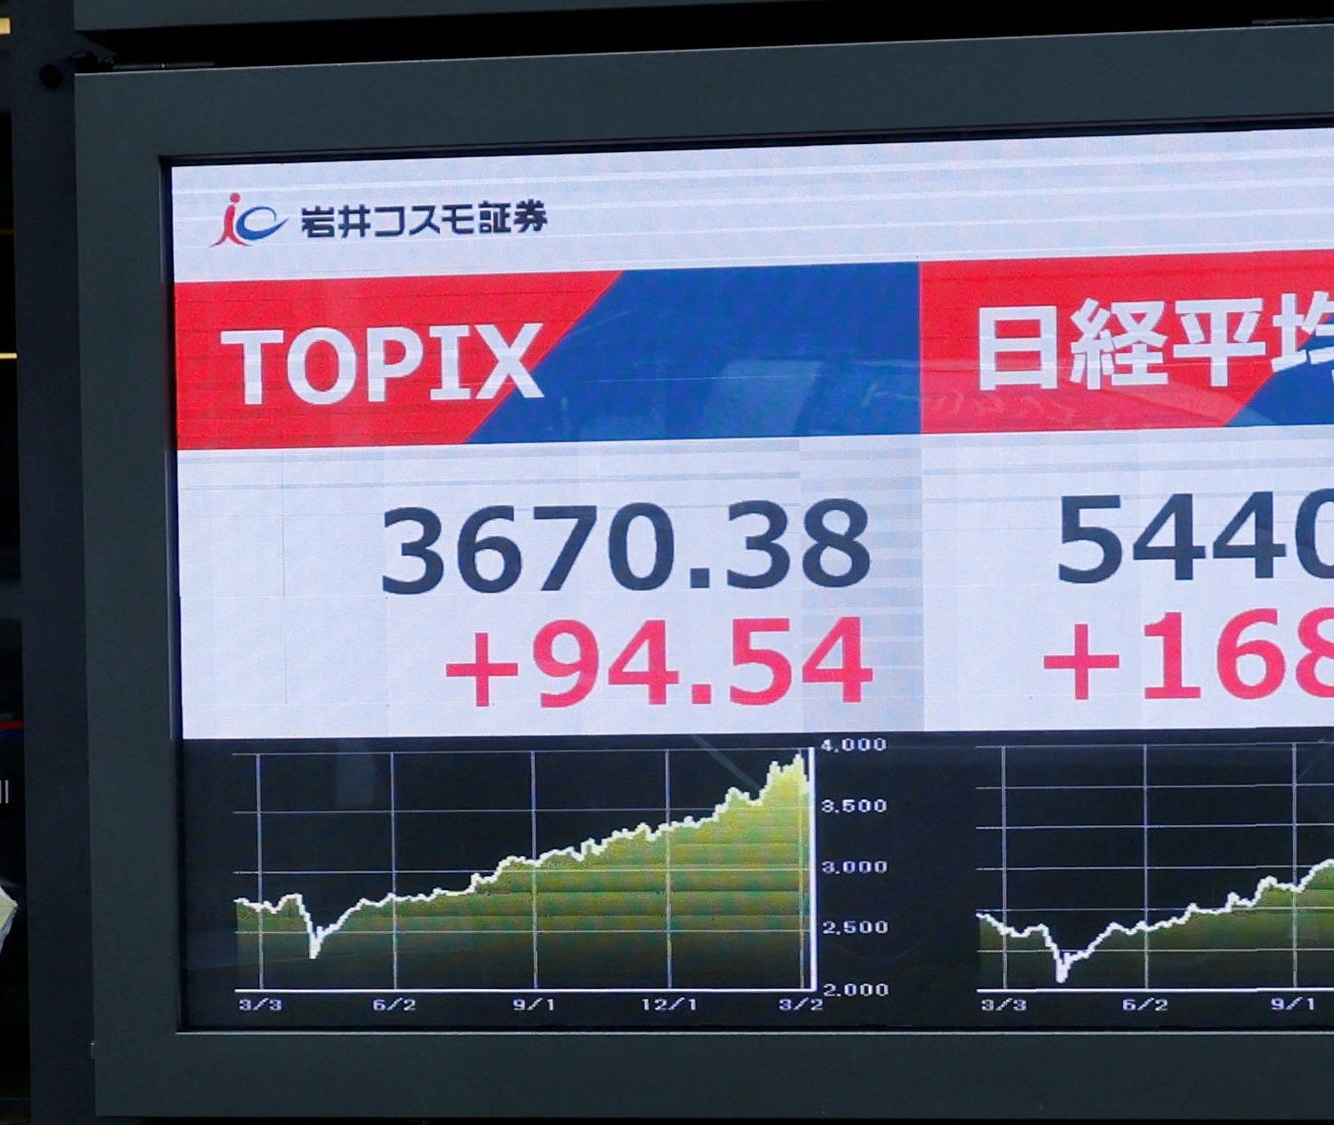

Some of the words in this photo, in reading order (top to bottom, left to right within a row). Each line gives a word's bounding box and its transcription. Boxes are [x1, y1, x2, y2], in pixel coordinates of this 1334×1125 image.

[302, 200, 547, 237] 岩井コスモ証券
[221, 323, 544, 404] TOPIX
[383, 499, 870, 594] 3670.38
[447, 617, 873, 707] +94.54
[239, 997, 282, 1011] 3/3
[373, 997, 416, 1011] 6/2
[513, 997, 554, 1011] 9/1
[642, 996, 696, 1011] 12/1
[778, 997, 823, 1011] 3/2
[981, 997, 1027, 1011] 3/3
[1122, 997, 1168, 1012] 6/2
[1270, 996, 1314, 1011] 9/1
